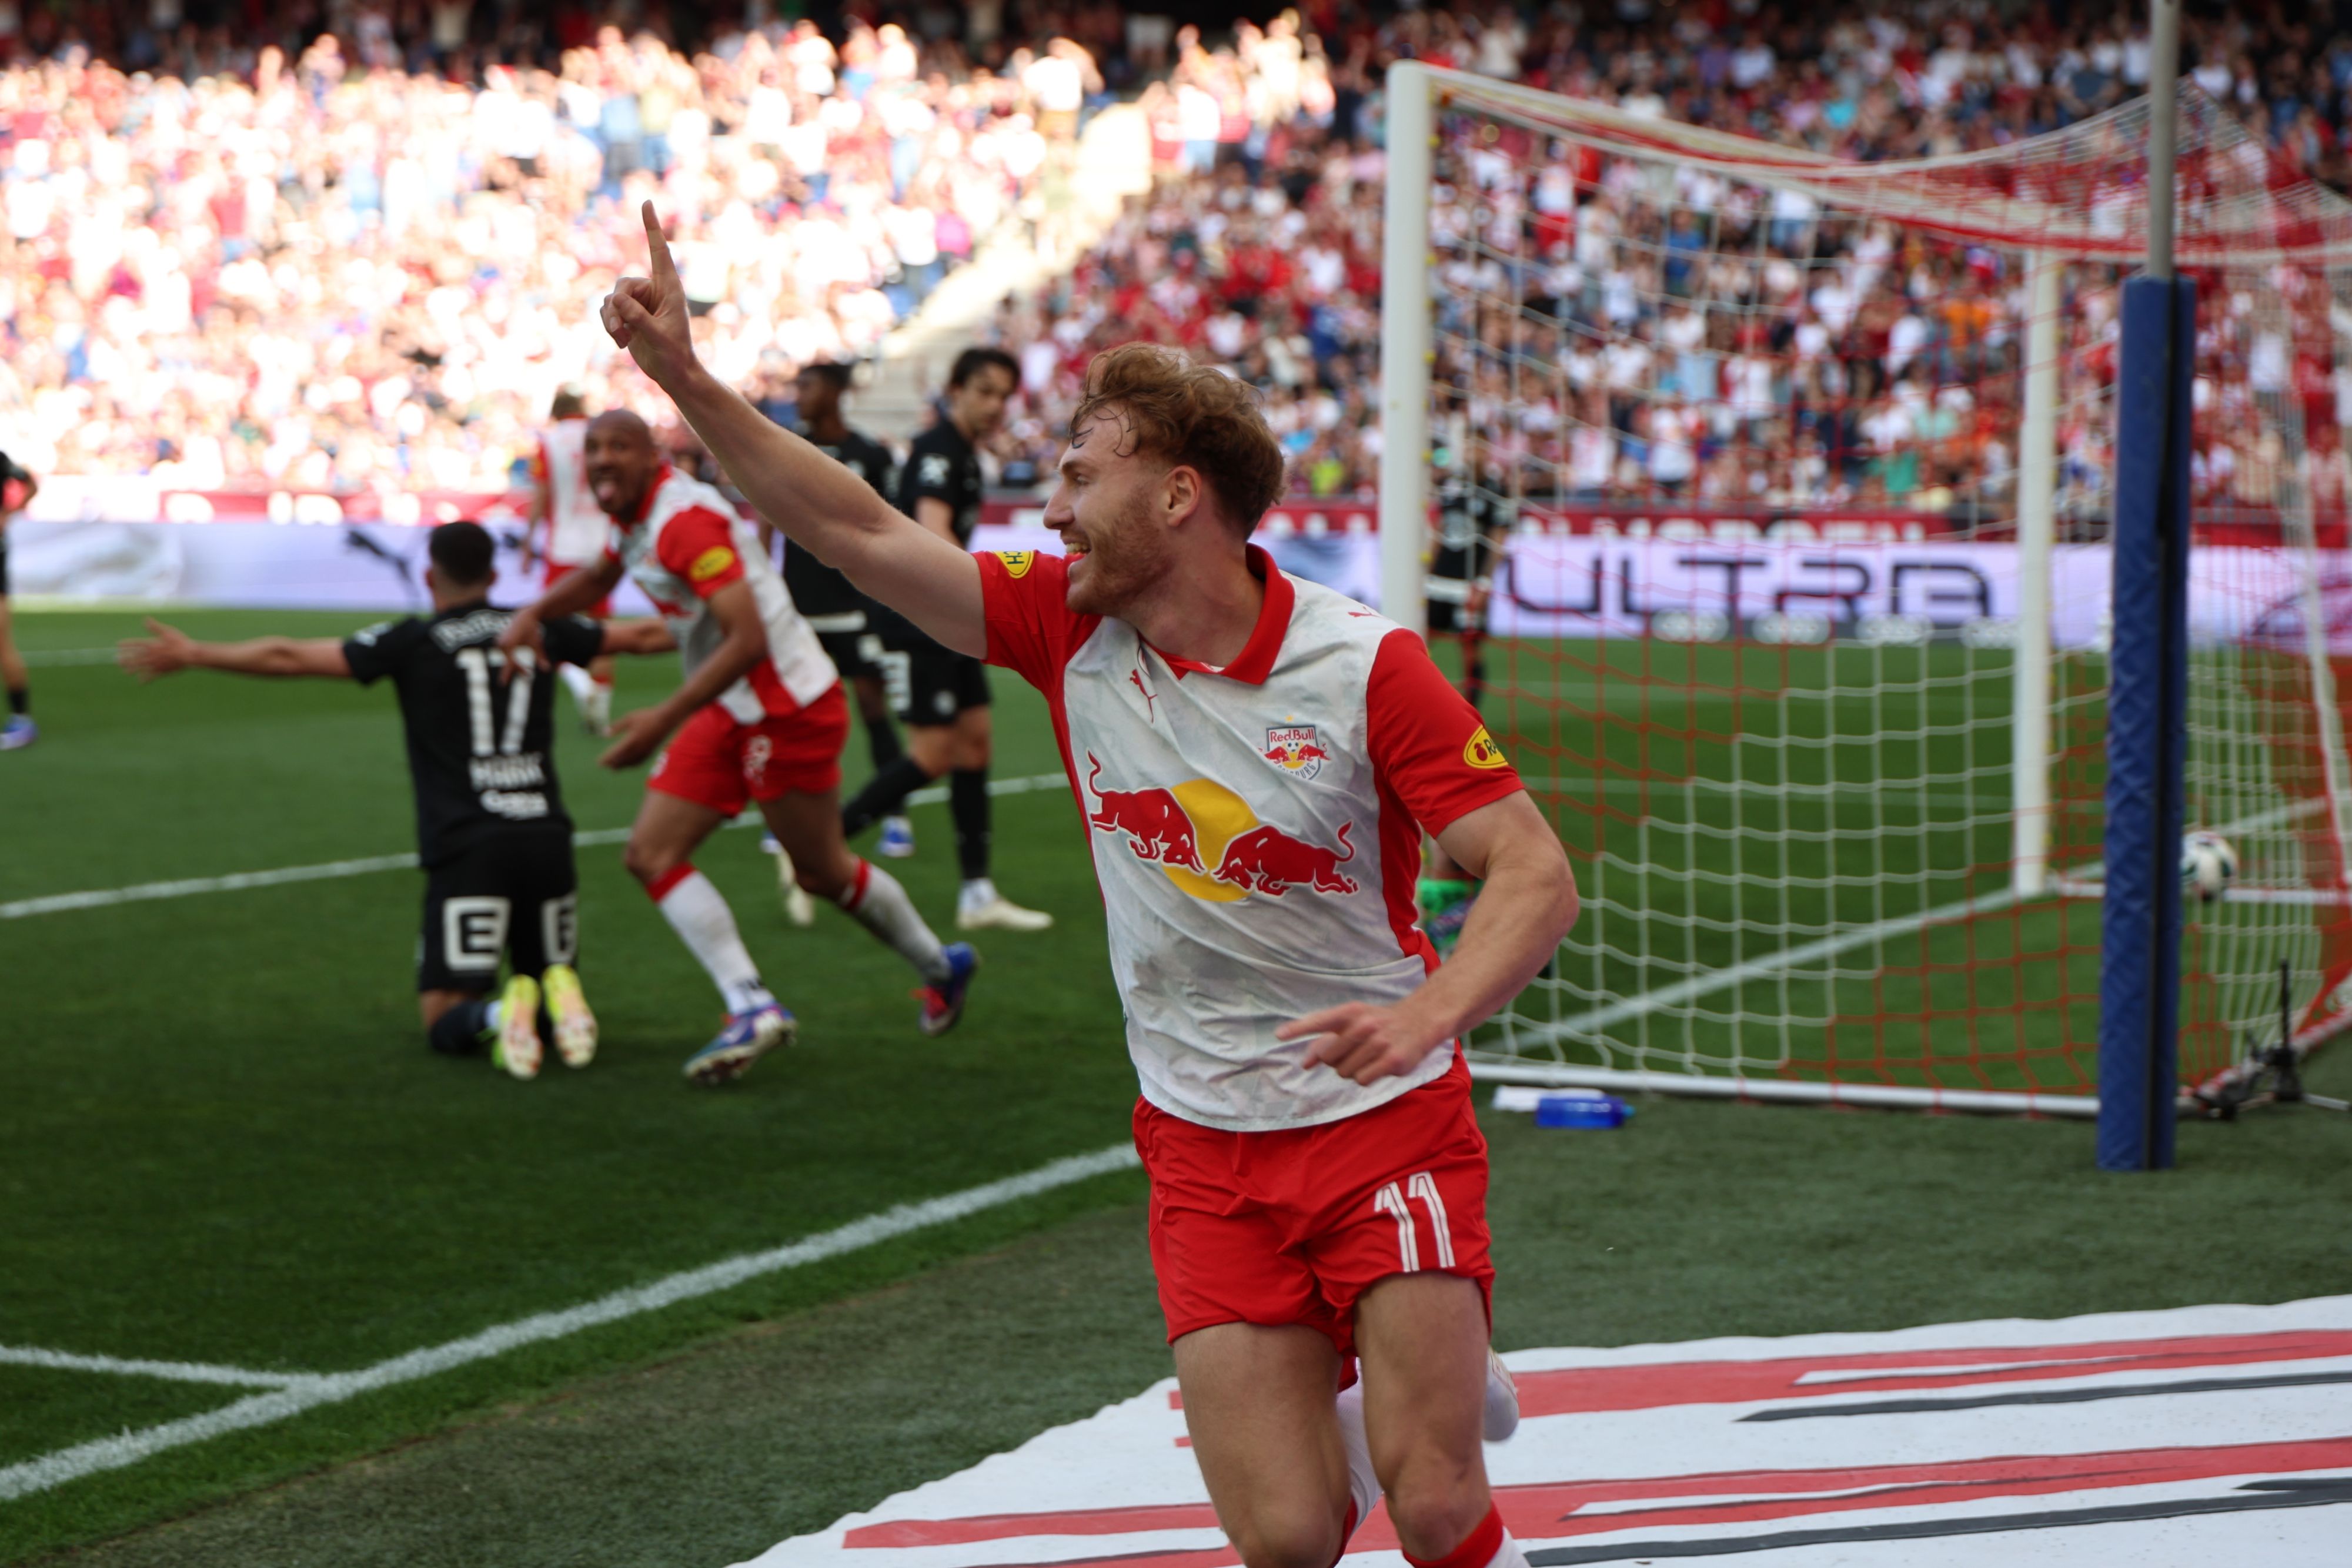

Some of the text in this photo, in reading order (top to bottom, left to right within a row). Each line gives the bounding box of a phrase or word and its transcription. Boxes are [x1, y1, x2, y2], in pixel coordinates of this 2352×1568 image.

[1506, 554, 1992, 617] ULTRA
[455, 647, 536, 757] 17
[1269, 728, 1315, 742] Red Bull
[1374, 1171, 1456, 1273] 11
